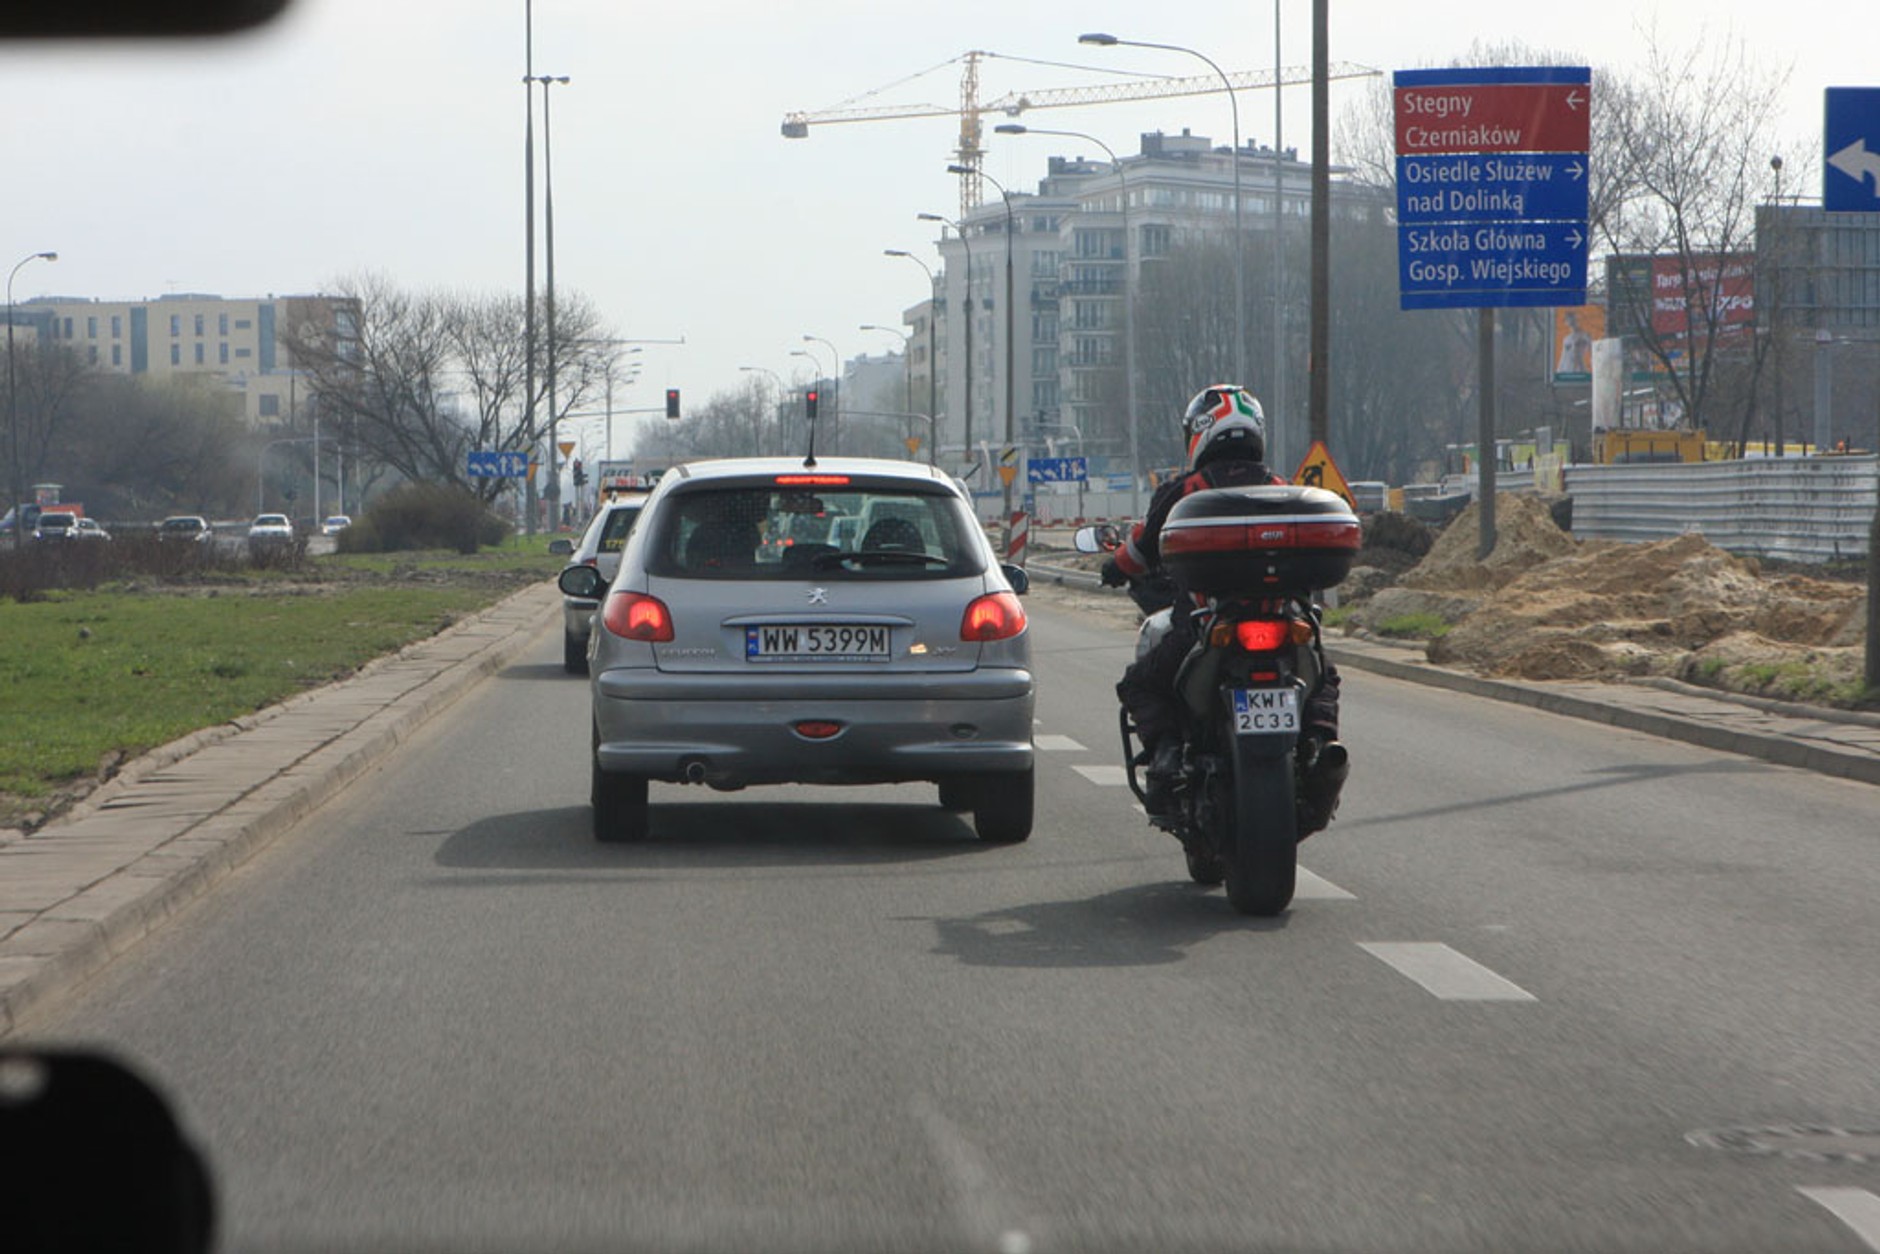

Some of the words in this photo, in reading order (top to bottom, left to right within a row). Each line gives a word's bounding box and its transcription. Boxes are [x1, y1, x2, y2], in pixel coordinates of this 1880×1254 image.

[1404, 92, 1472, 117] Stegny
[1405, 125, 1521, 147] Czerniaków
[1406, 160, 1481, 183] Osiedle
[1486, 160, 1552, 181] Służew
[1407, 190, 1444, 212] nad
[1451, 189, 1524, 215] Dolinką
[1408, 229, 1470, 252] Szkoła
[1475, 228, 1546, 250] Główna
[1409, 260, 1465, 285] Gosp.
[1471, 258, 1571, 284] Wiejskiego
[763, 628, 799, 652] WW
[807, 628, 886, 652] 5399M
[1239, 712, 1295, 730] 2C33
